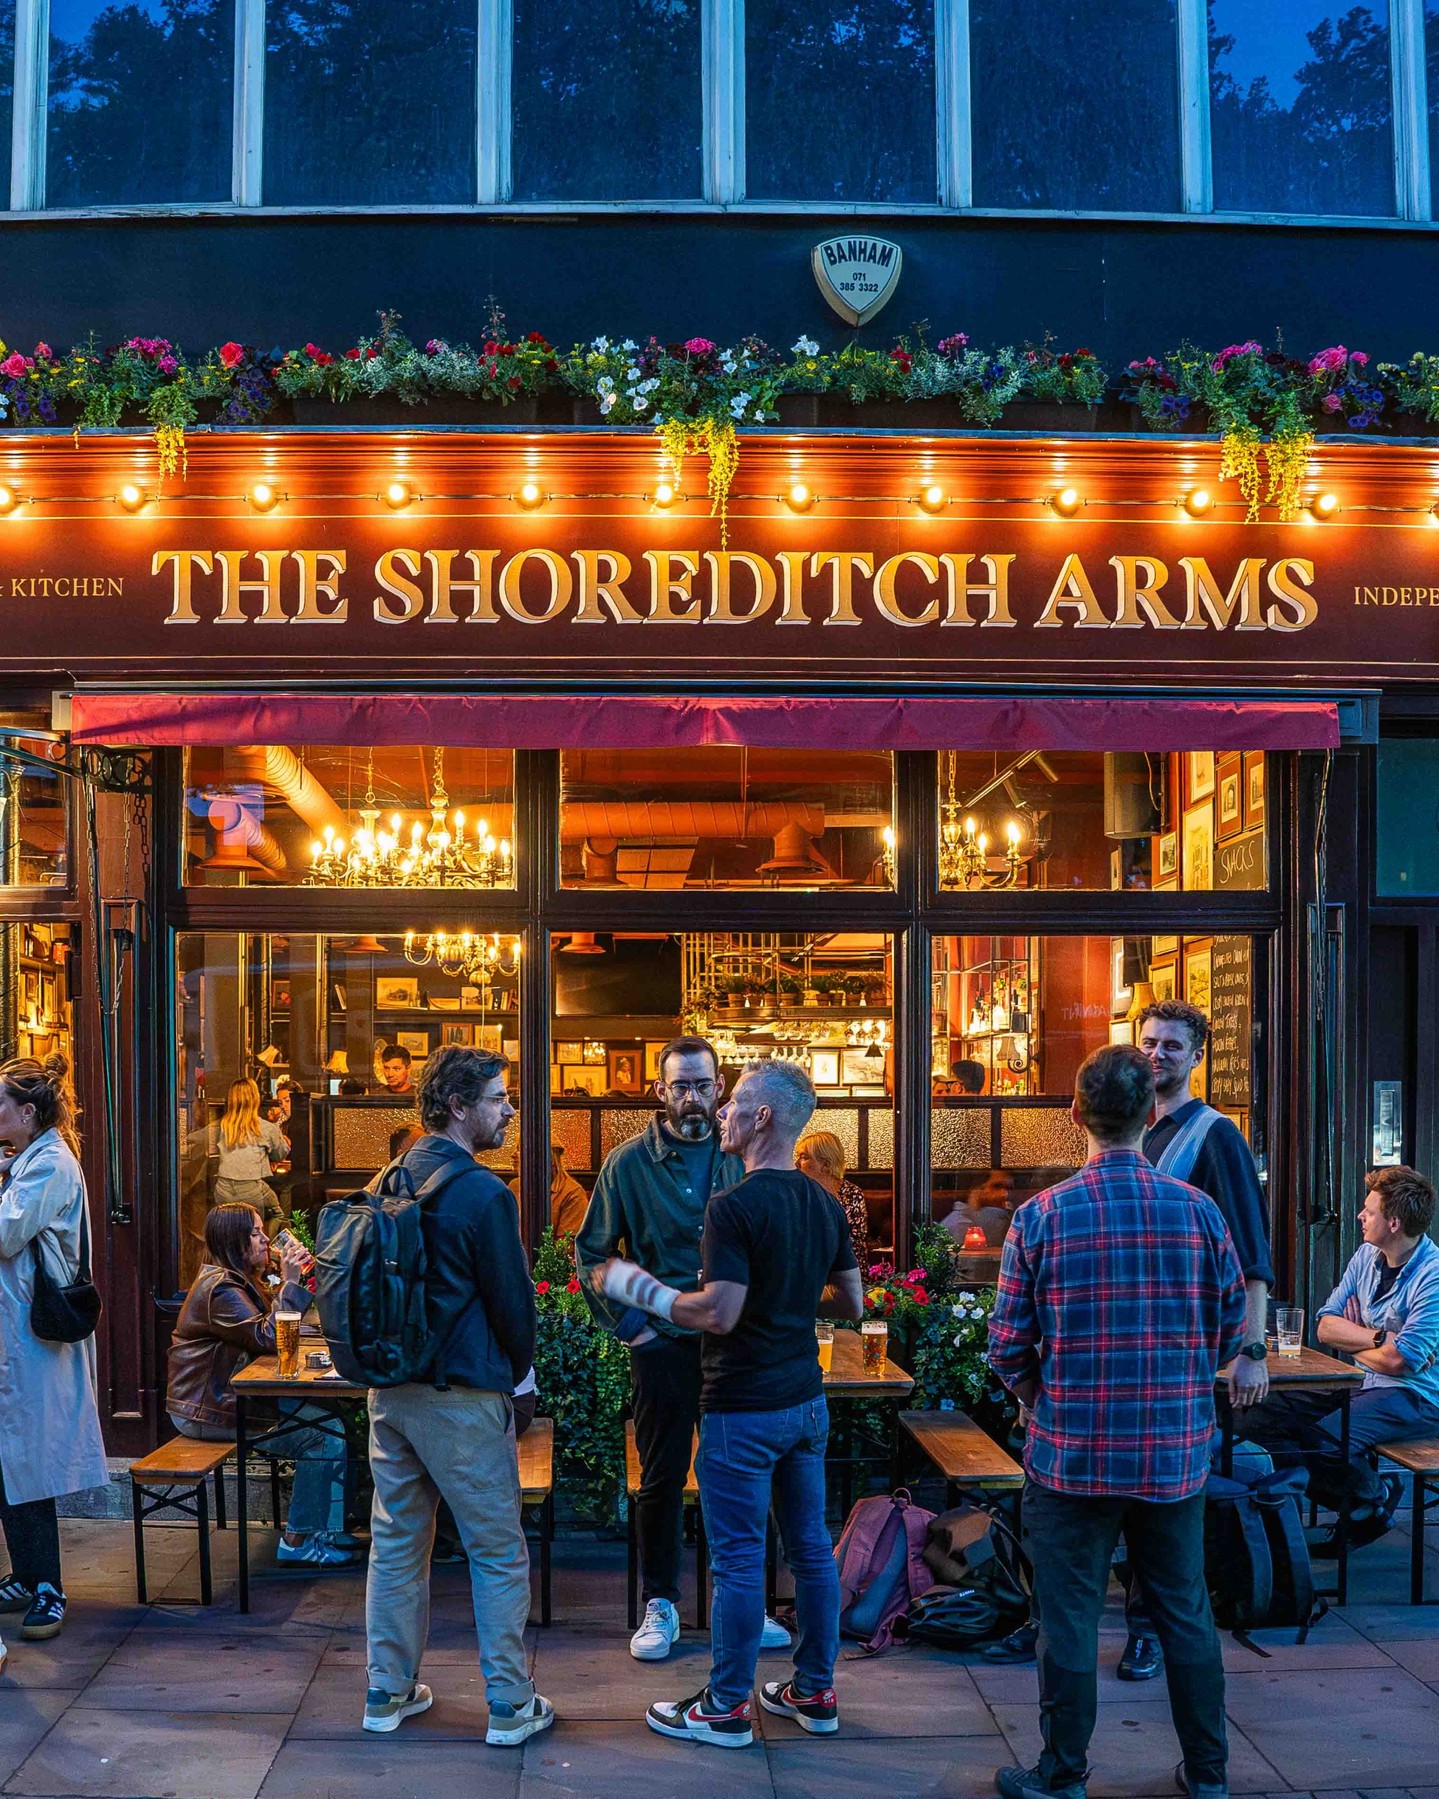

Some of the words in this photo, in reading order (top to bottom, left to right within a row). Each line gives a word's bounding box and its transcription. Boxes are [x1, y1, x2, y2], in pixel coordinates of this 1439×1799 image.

[823, 240, 894, 267] BANHAM
[852, 272, 867, 281] 071
[839, 282, 855, 292] 385
[858, 283, 879, 293] 3322
[11, 577, 124, 597] KITCHEN
[151, 549, 348, 625] THE
[373, 548, 1018, 629] SHOREDITCH
[1033, 552, 1319, 632] ARMS
